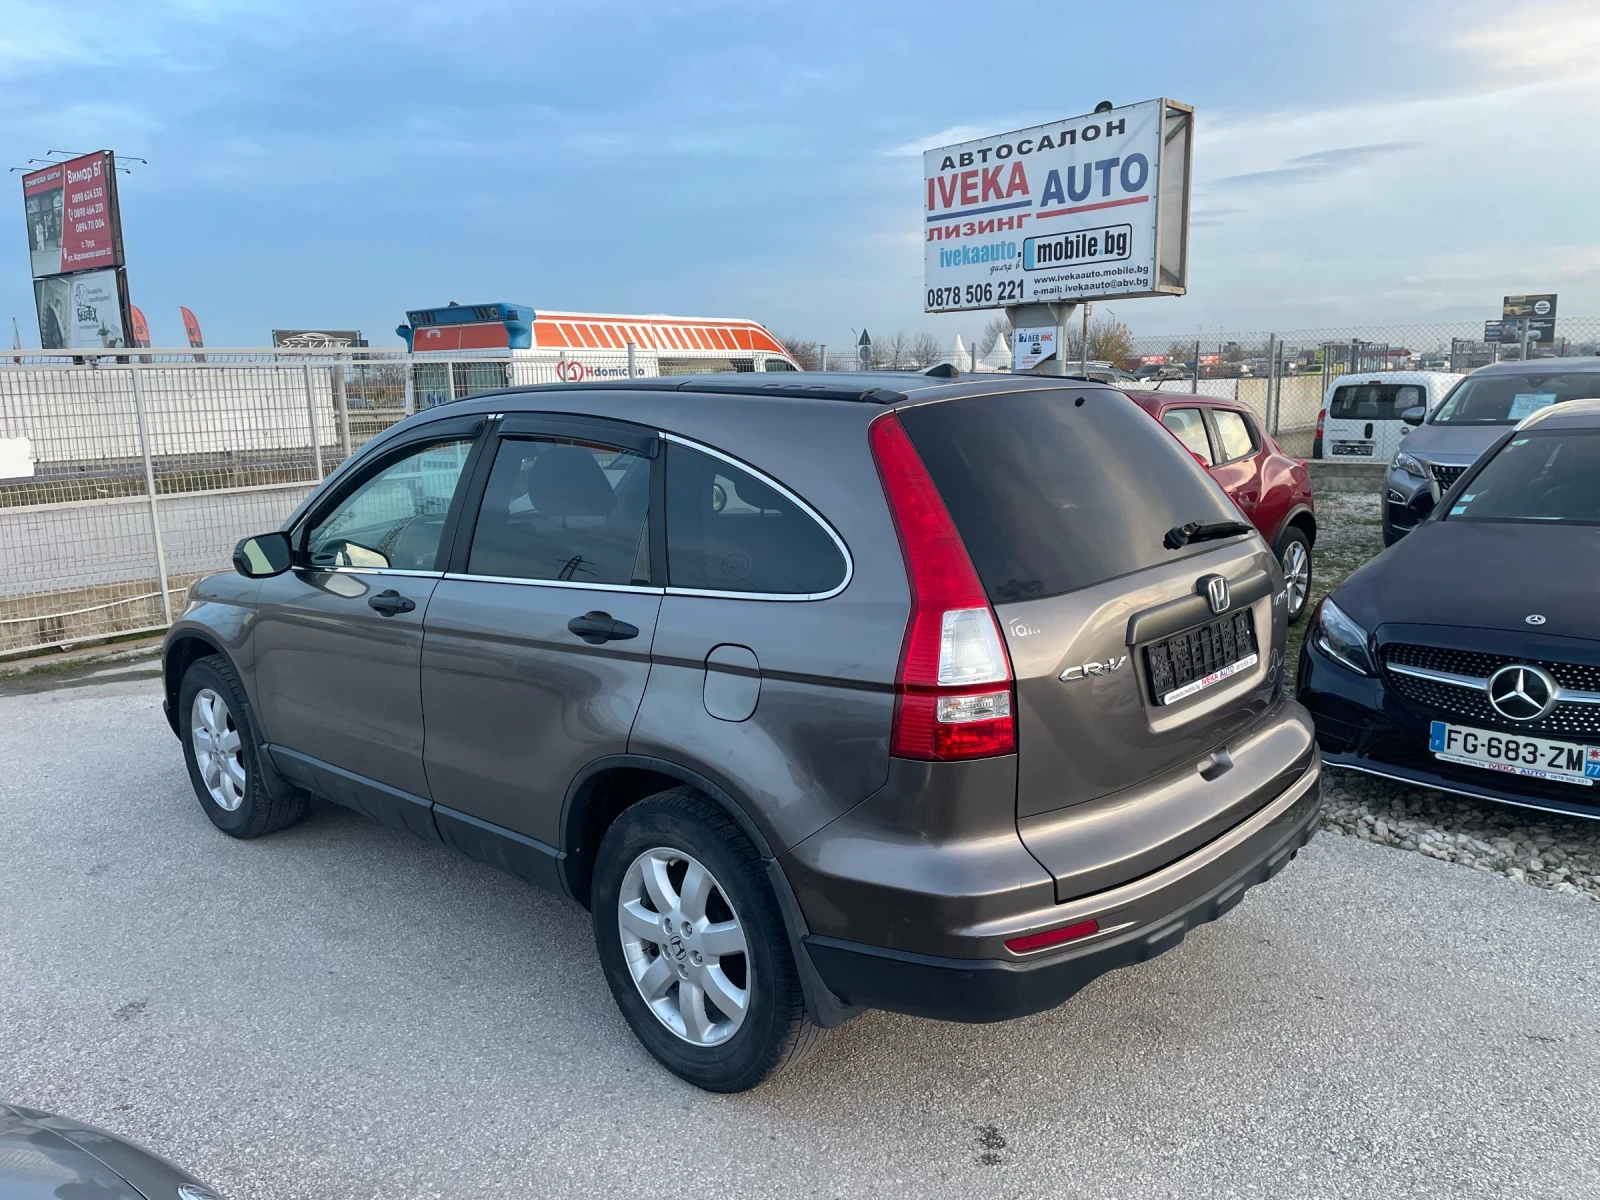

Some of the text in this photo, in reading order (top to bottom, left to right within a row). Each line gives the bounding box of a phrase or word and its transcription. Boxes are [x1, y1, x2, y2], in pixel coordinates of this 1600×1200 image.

[940, 118, 1126, 171] АВТОСАЛОН
[67, 161, 102, 184] Вимар БГ
[928, 152, 1149, 211] IVEKA AUTO
[927, 213, 1031, 242] ЛИЗИНГ
[1037, 230, 1127, 263] mobile.bg
[1033, 277, 1149, 296] e-mail: ivekaauto@abv.bg
[1034, 265, 1149, 284] www.ivekaauto.mobile.bg
[927, 279, 1024, 307] 0878 506 221
[1059, 655, 1128, 683] CR-V
[1201, 673, 1219, 687] IVEKA
[1219, 665, 1235, 678] AUTO
[1446, 728, 1584, 771] FG-683-ZM
[1489, 763, 1517, 773] IVEKA
[1520, 768, 1547, 777] AUTO
[1586, 763, 1600, 776] 77
